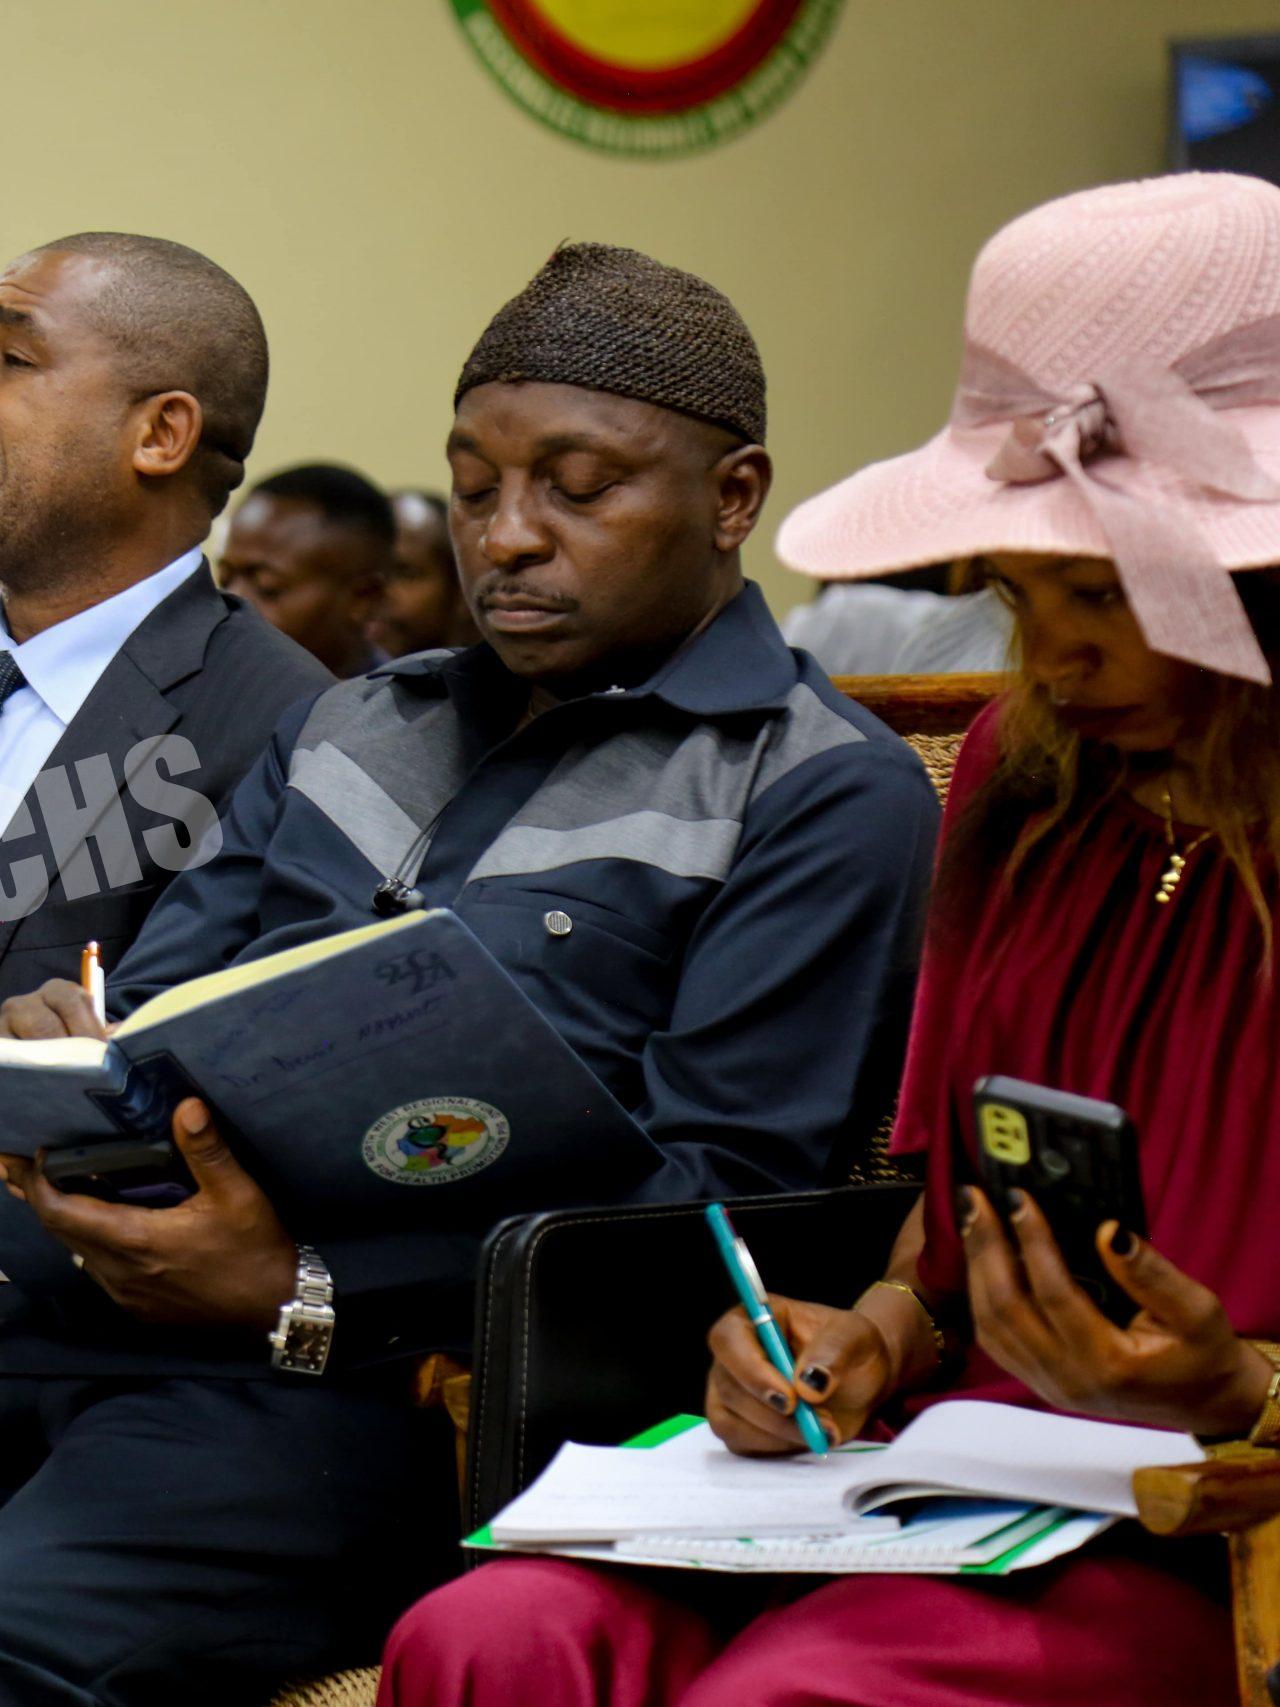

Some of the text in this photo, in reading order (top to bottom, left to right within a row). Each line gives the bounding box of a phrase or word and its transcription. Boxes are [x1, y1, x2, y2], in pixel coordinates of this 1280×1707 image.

[373, 1111, 401, 1133] WEST
[403, 1096, 470, 1112] REGIONAL
[375, 1163, 394, 1179] FOR
[397, 1173, 448, 1185] HEALTH
